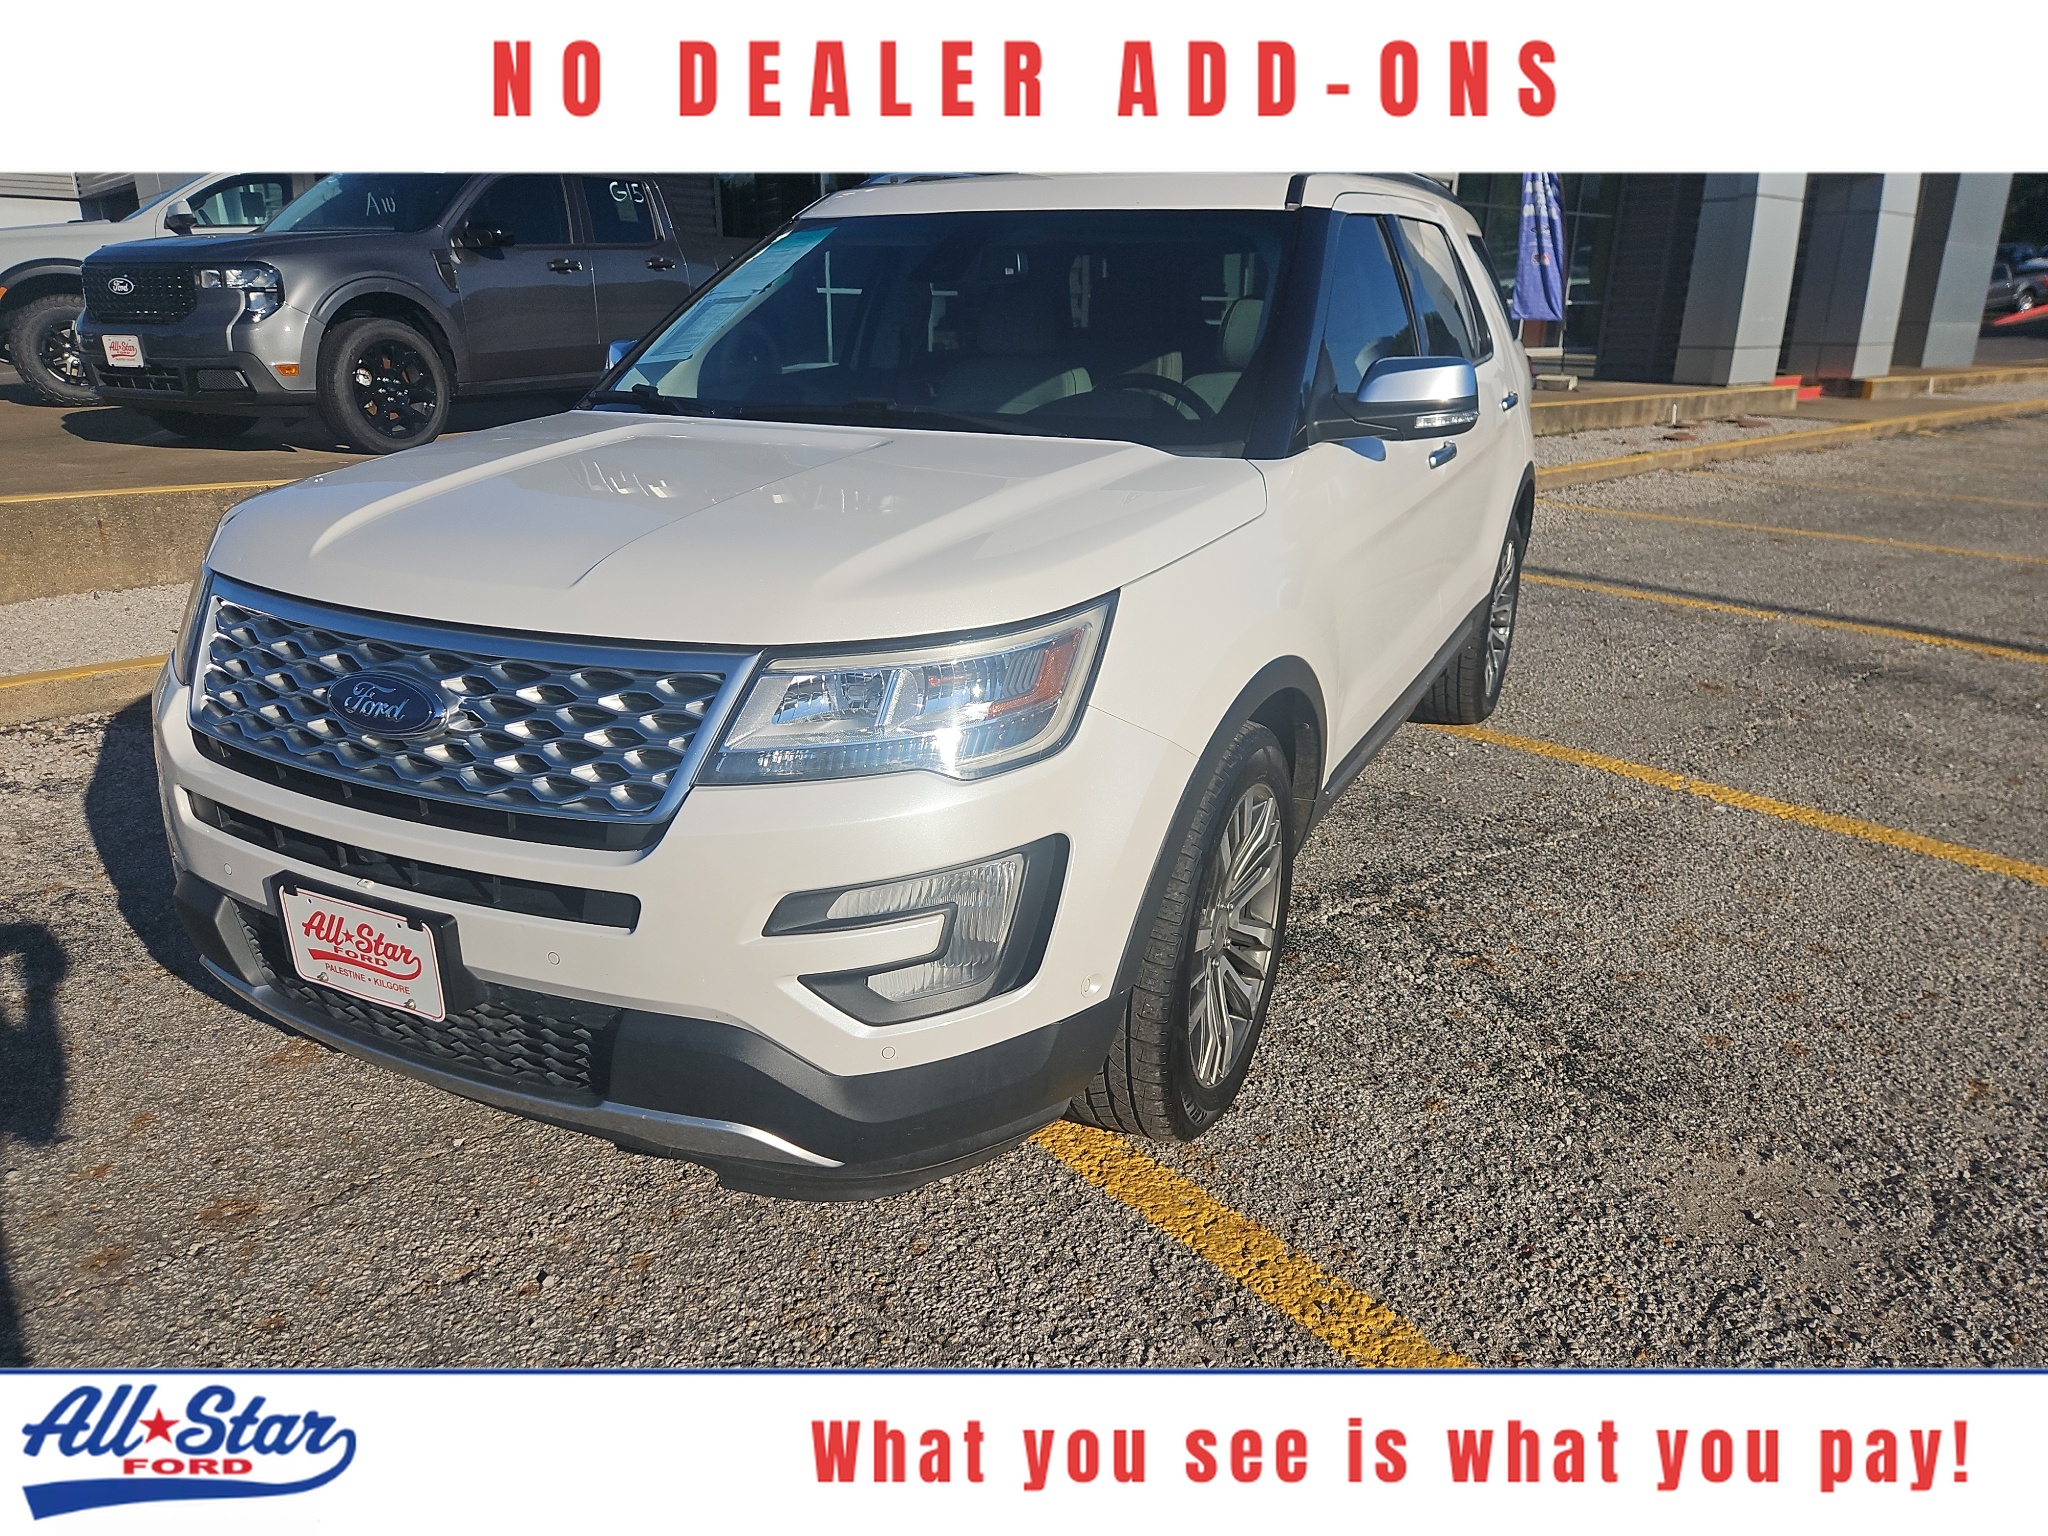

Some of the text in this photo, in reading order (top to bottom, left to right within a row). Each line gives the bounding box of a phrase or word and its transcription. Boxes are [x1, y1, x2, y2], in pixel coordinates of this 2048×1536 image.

[609, 181, 644, 203] G15
[112, 280, 129, 292] Ford
[109, 341, 120, 352] All
[344, 681, 410, 722] Ford
[302, 911, 416, 966] All Star
[333, 946, 388, 967] FORD
[325, 963, 411, 995] PALESTINE KILGORE
